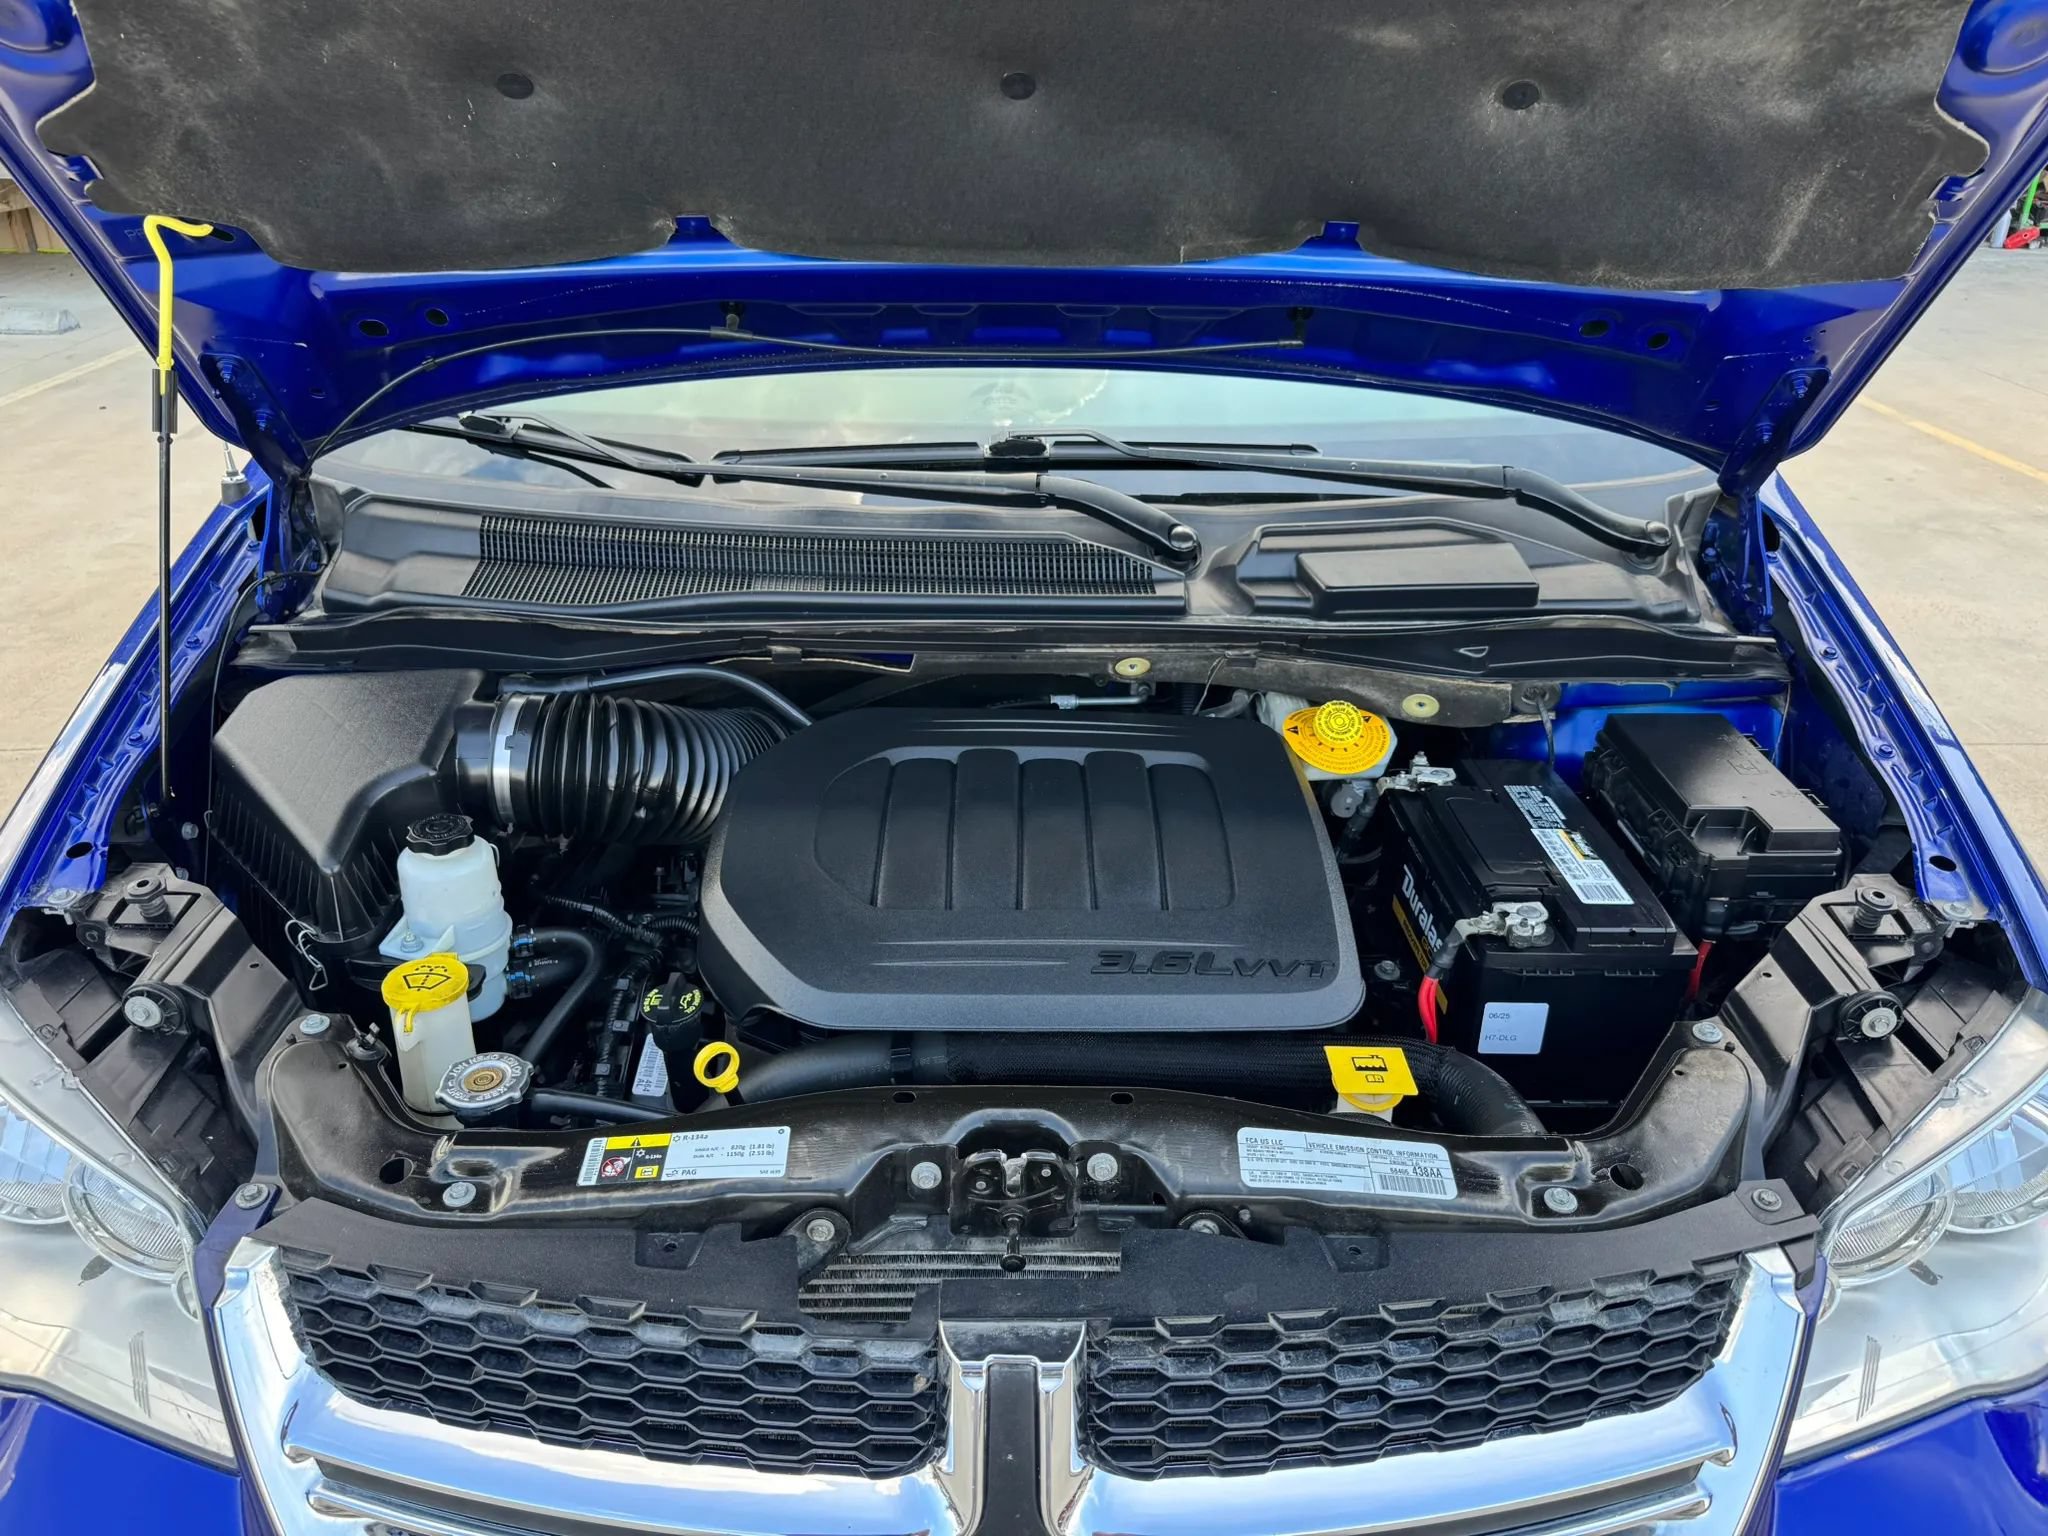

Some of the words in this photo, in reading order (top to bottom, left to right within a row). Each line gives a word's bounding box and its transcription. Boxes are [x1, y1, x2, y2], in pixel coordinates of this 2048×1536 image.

[1402, 863, 1443, 953] Duralas
[1488, 1012, 1511, 1020] 06/25
[1308, 1142, 1333, 1150] VEHICLE
[1335, 1144, 1365, 1153] EMISSION
[1366, 1147, 1395, 1156] CONTROL
[1396, 1150, 1439, 1159] INFORMATION
[1412, 1166, 1443, 1178] 438AA
